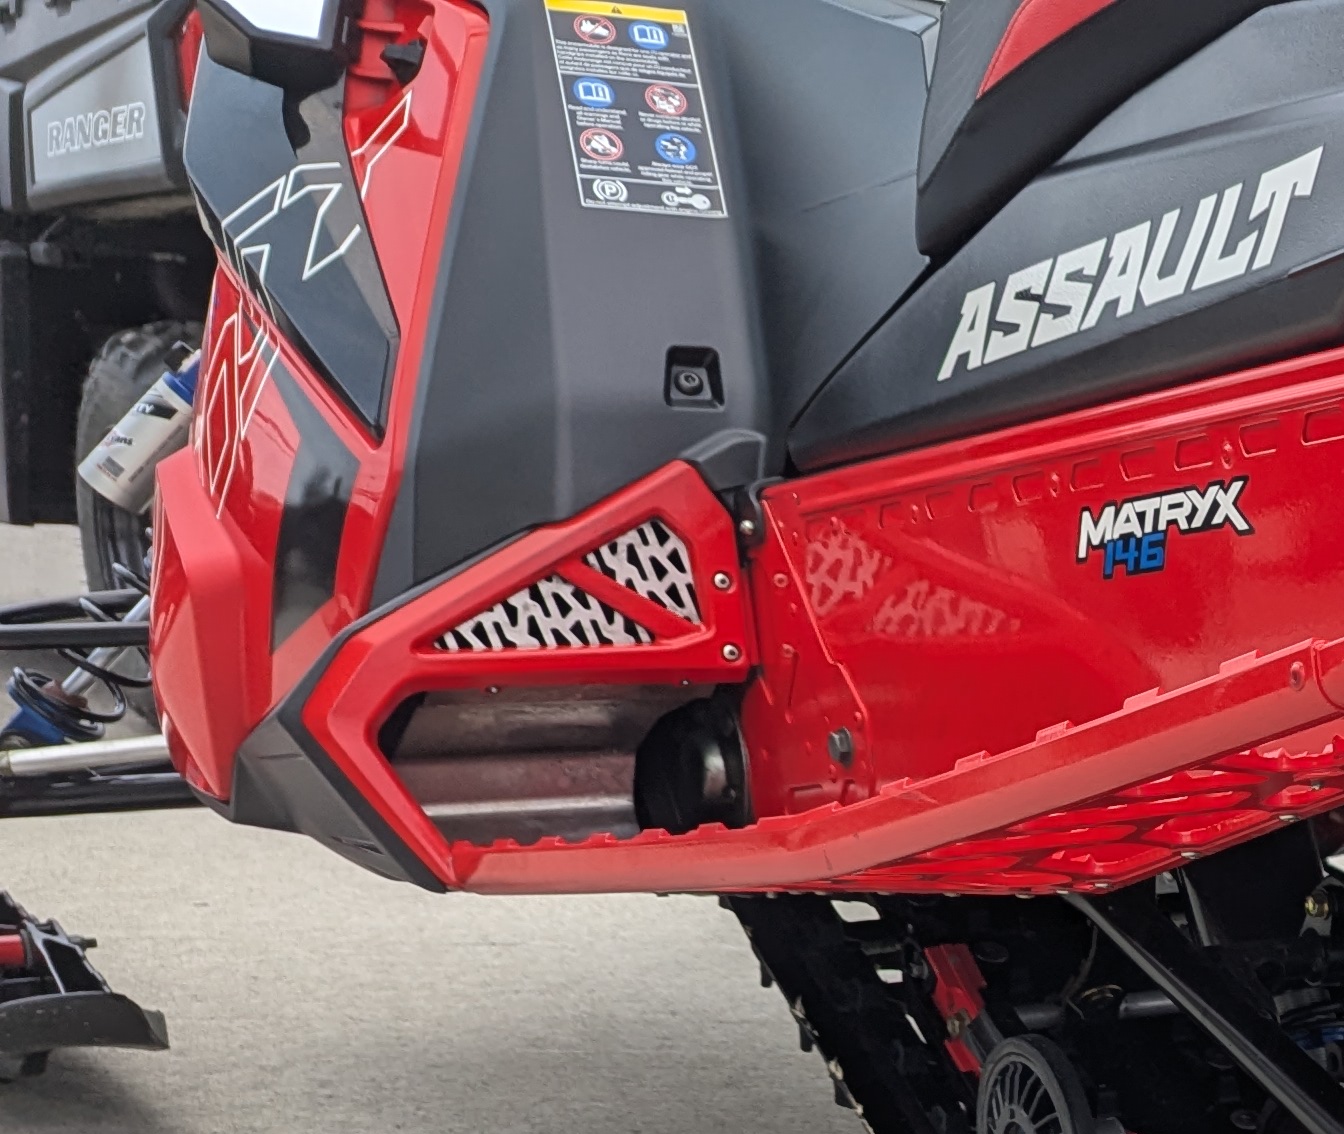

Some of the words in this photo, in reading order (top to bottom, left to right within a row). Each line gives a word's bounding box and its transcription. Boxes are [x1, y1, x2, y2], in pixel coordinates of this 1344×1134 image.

[47, 101, 146, 158] RANGER
[936, 145, 1324, 382] ASSAULT
[1077, 480, 1250, 559] MATRYX
[1104, 532, 1165, 576] 146
